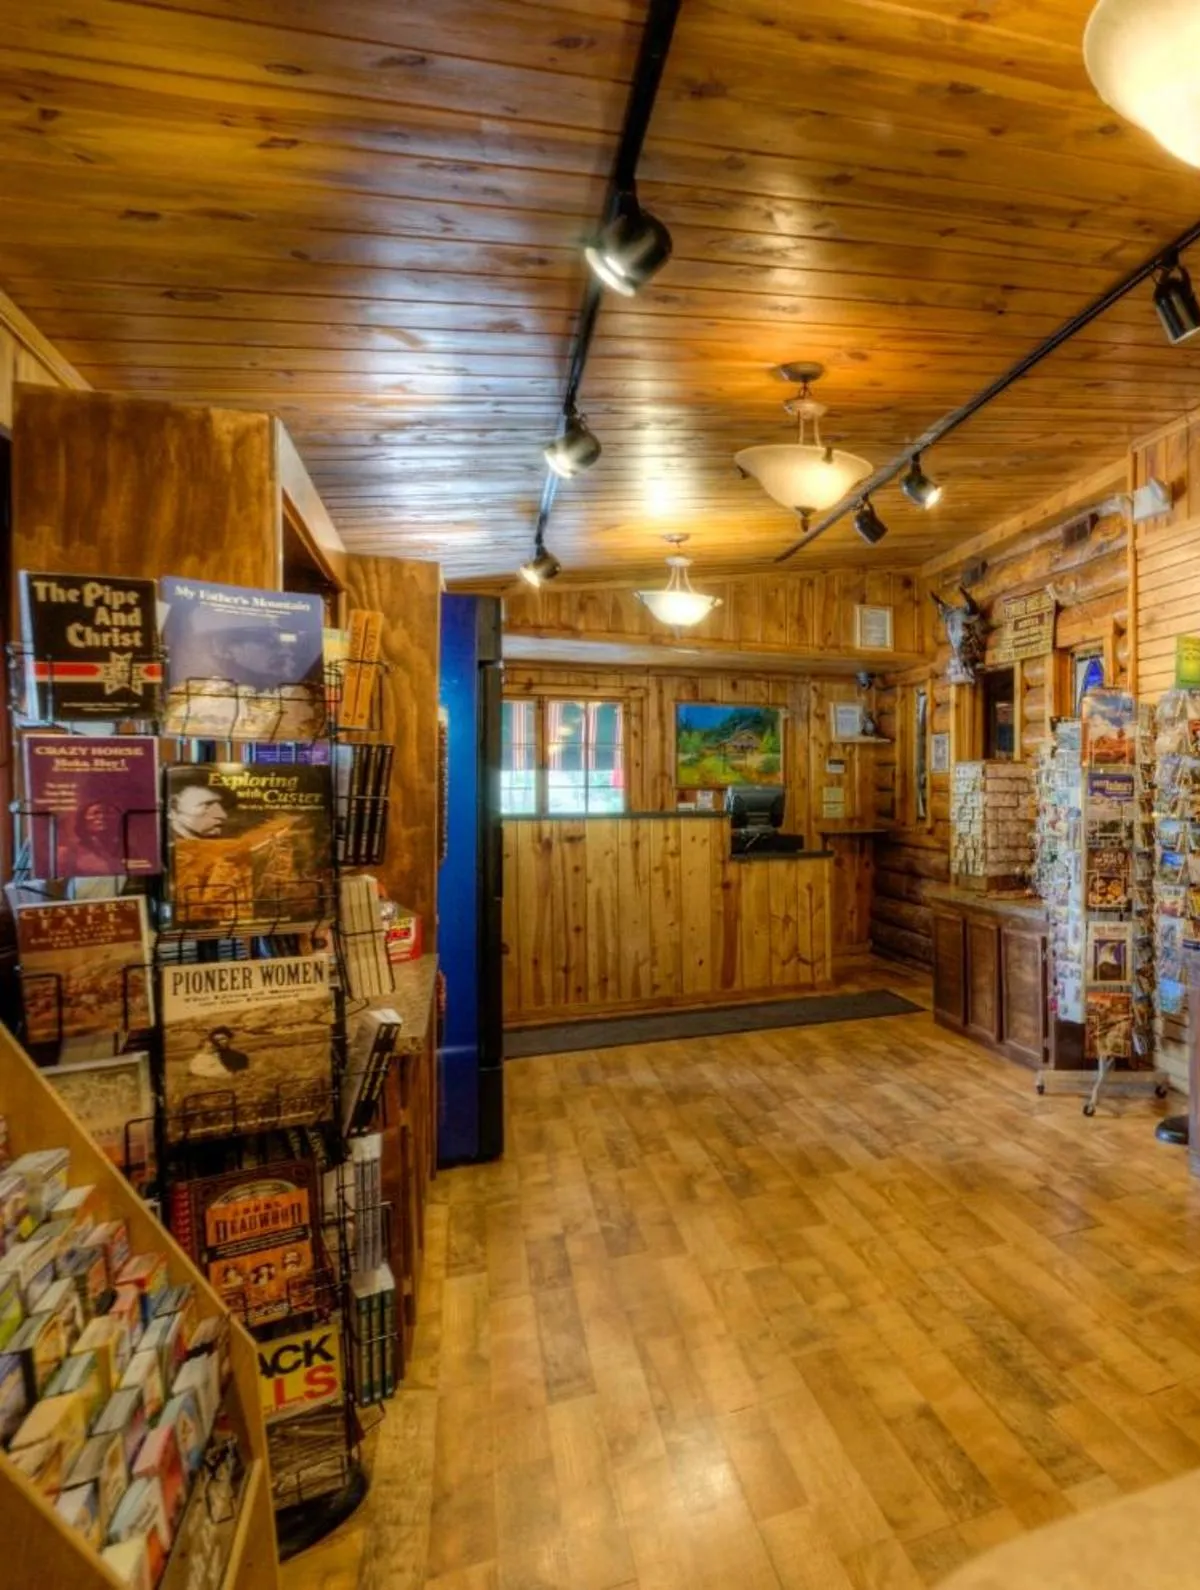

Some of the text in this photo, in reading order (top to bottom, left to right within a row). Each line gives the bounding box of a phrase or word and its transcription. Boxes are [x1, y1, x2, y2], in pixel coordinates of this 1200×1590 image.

[32, 581, 140, 610] The Pipe
[174, 585, 196, 599] My
[252, 596, 311, 612] Mountain
[94, 605, 142, 626] And
[66, 622, 143, 648] Christ
[35, 746, 144, 756] CRAZY HORSE
[208, 771, 298, 791] Exploring
[237, 788, 323, 803] with Custer
[19, 902, 137, 920] CUSTER'S
[171, 967, 253, 996] PIONEER
[260, 960, 325, 987] WOMEN
[214, 1202, 302, 1242] DEADWOOD
